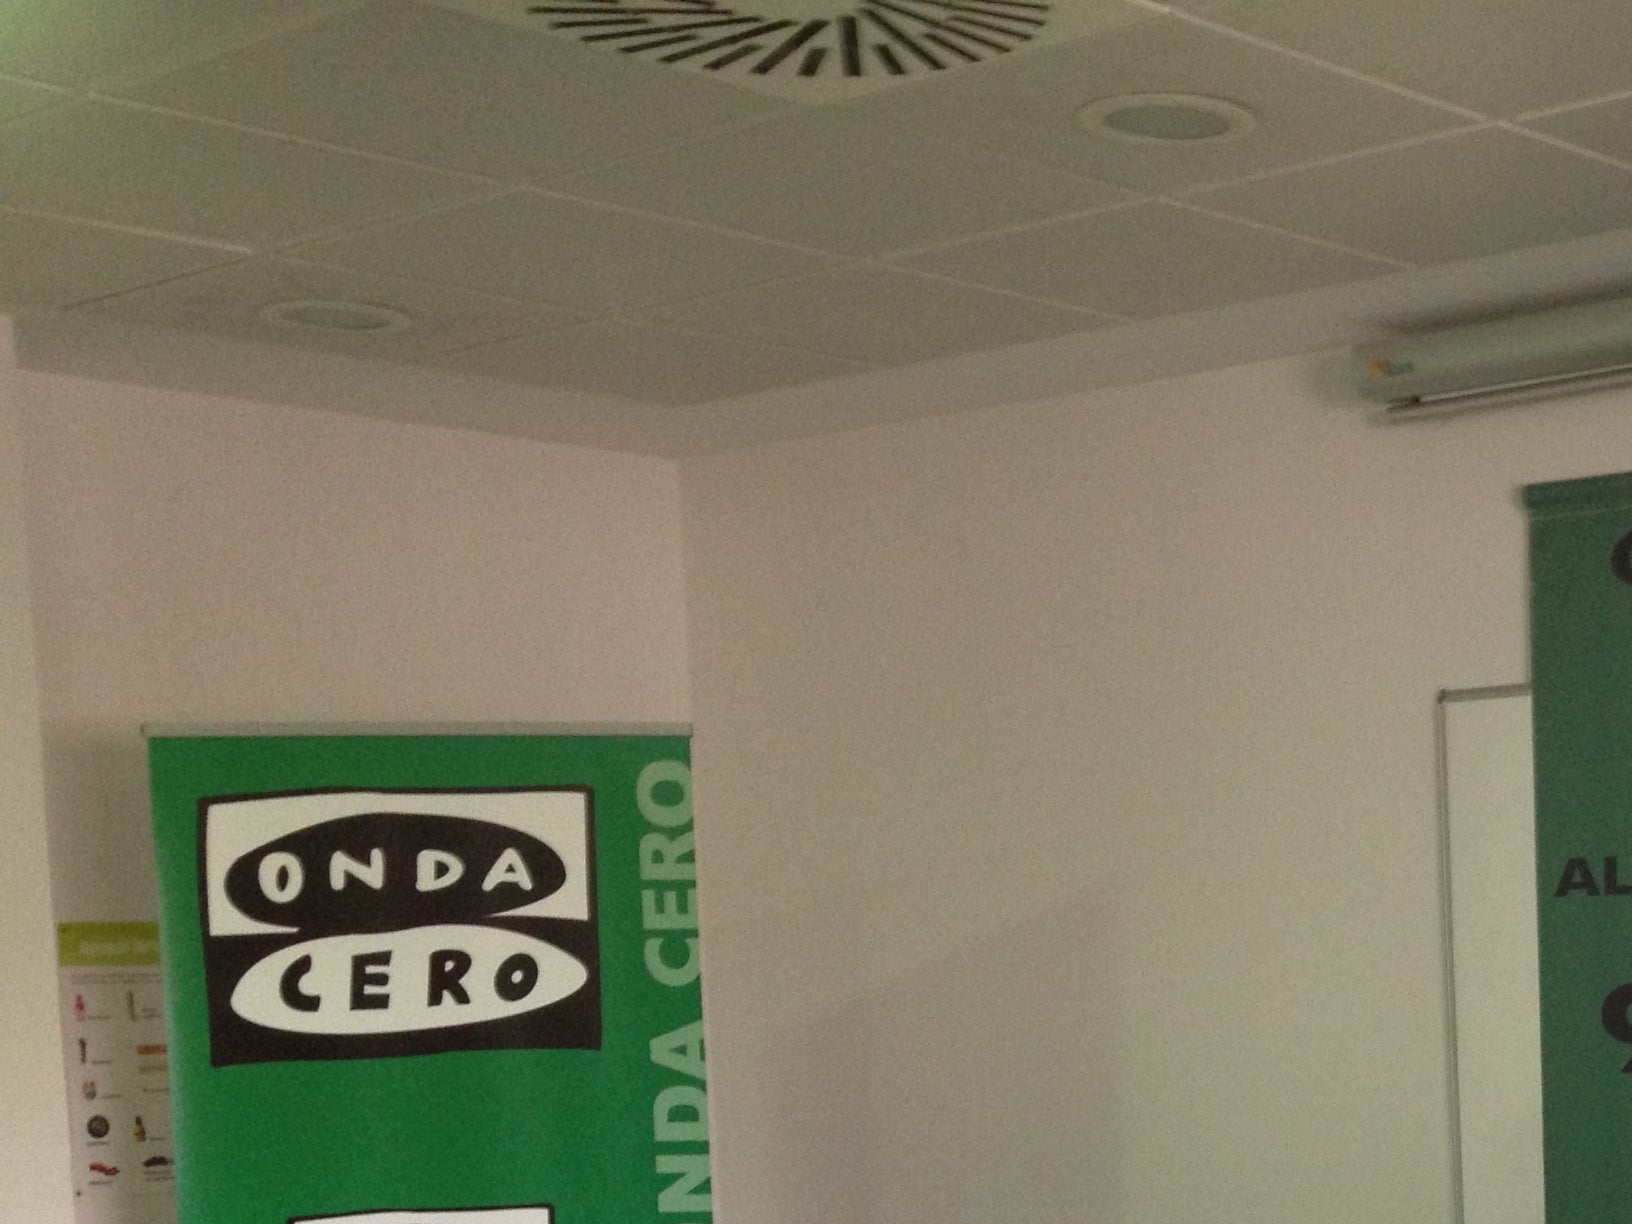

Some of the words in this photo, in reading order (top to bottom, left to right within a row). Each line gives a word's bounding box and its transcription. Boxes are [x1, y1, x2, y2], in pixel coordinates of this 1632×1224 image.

[258, 847, 534, 904] ONDA
[635, 759, 703, 988] CERO
[279, 949, 539, 1012] CERO
